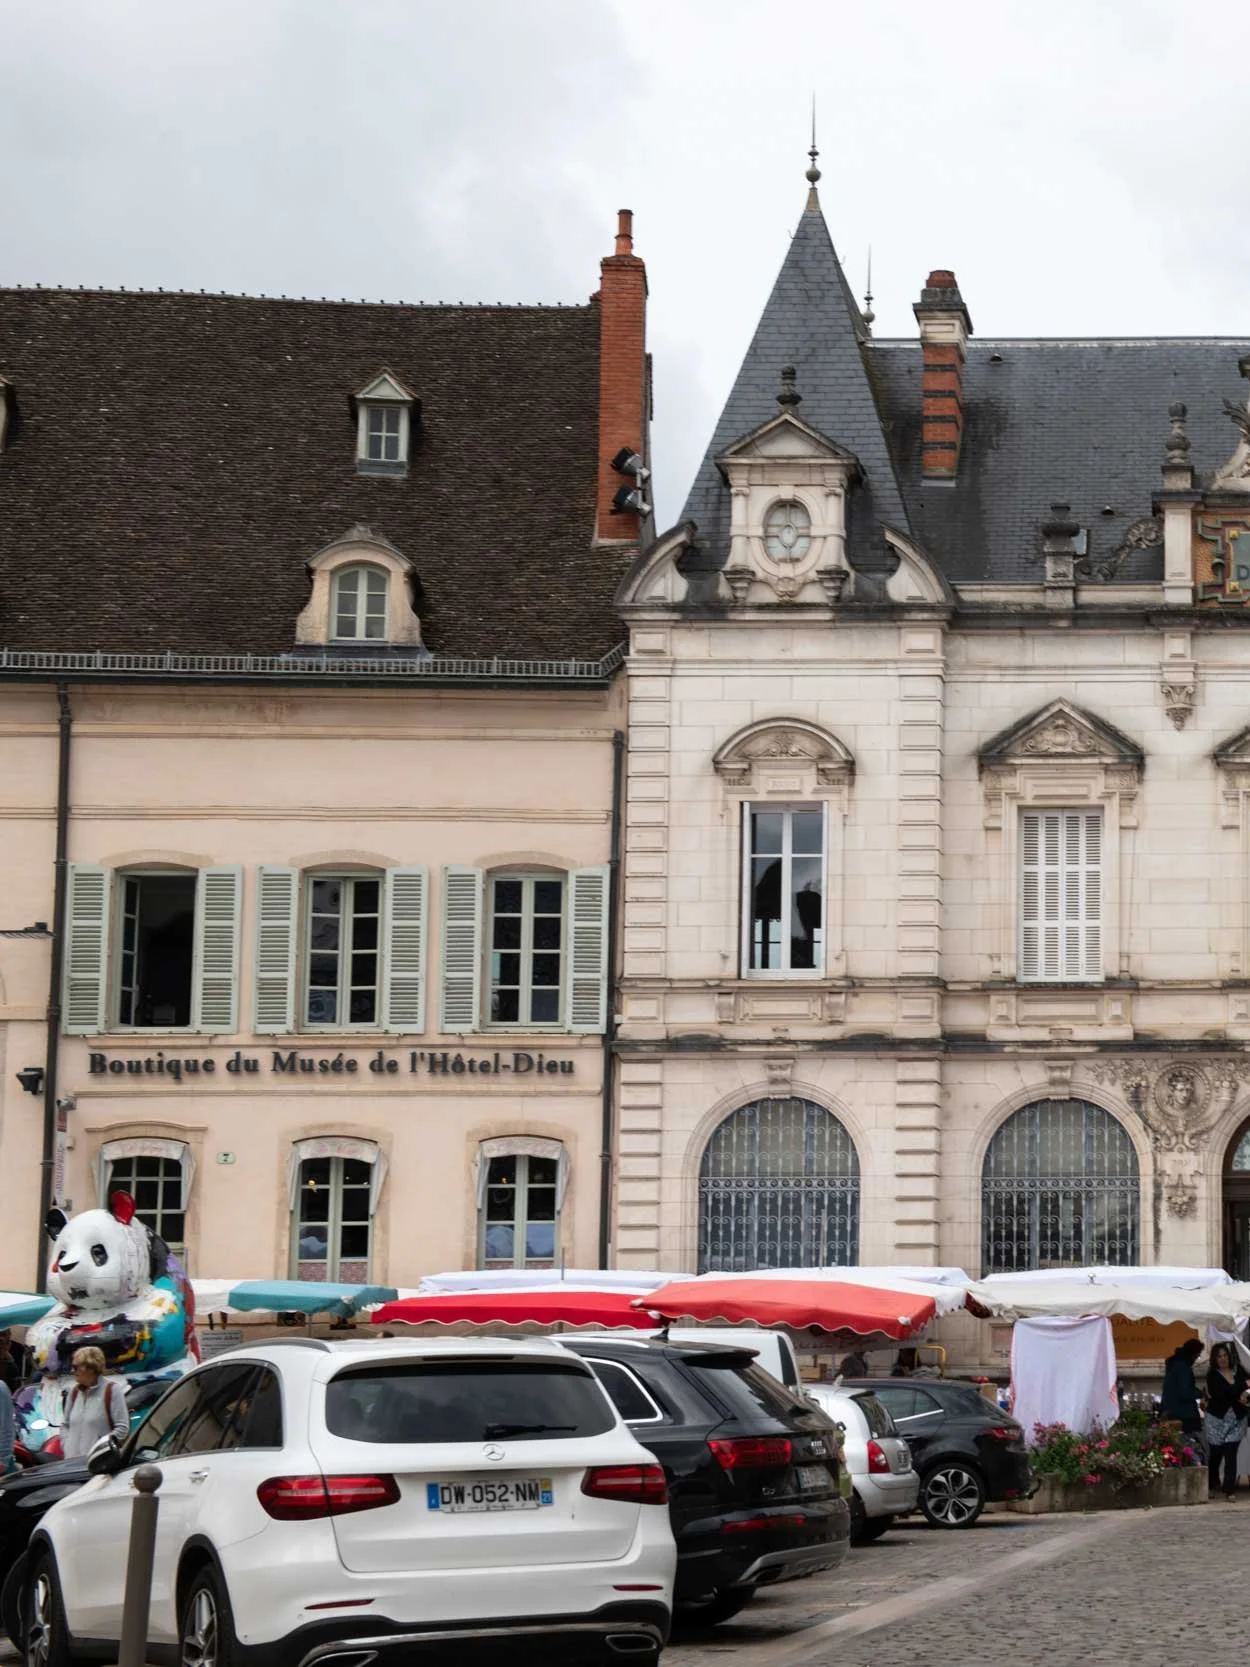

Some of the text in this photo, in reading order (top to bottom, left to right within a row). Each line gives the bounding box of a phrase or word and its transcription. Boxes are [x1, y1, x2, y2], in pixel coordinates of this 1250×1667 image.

[88, 1051, 575, 1080] Boutique du Musée de l'Hôtel-Dieu
[440, 1482, 540, 1505] DW-052-NM
